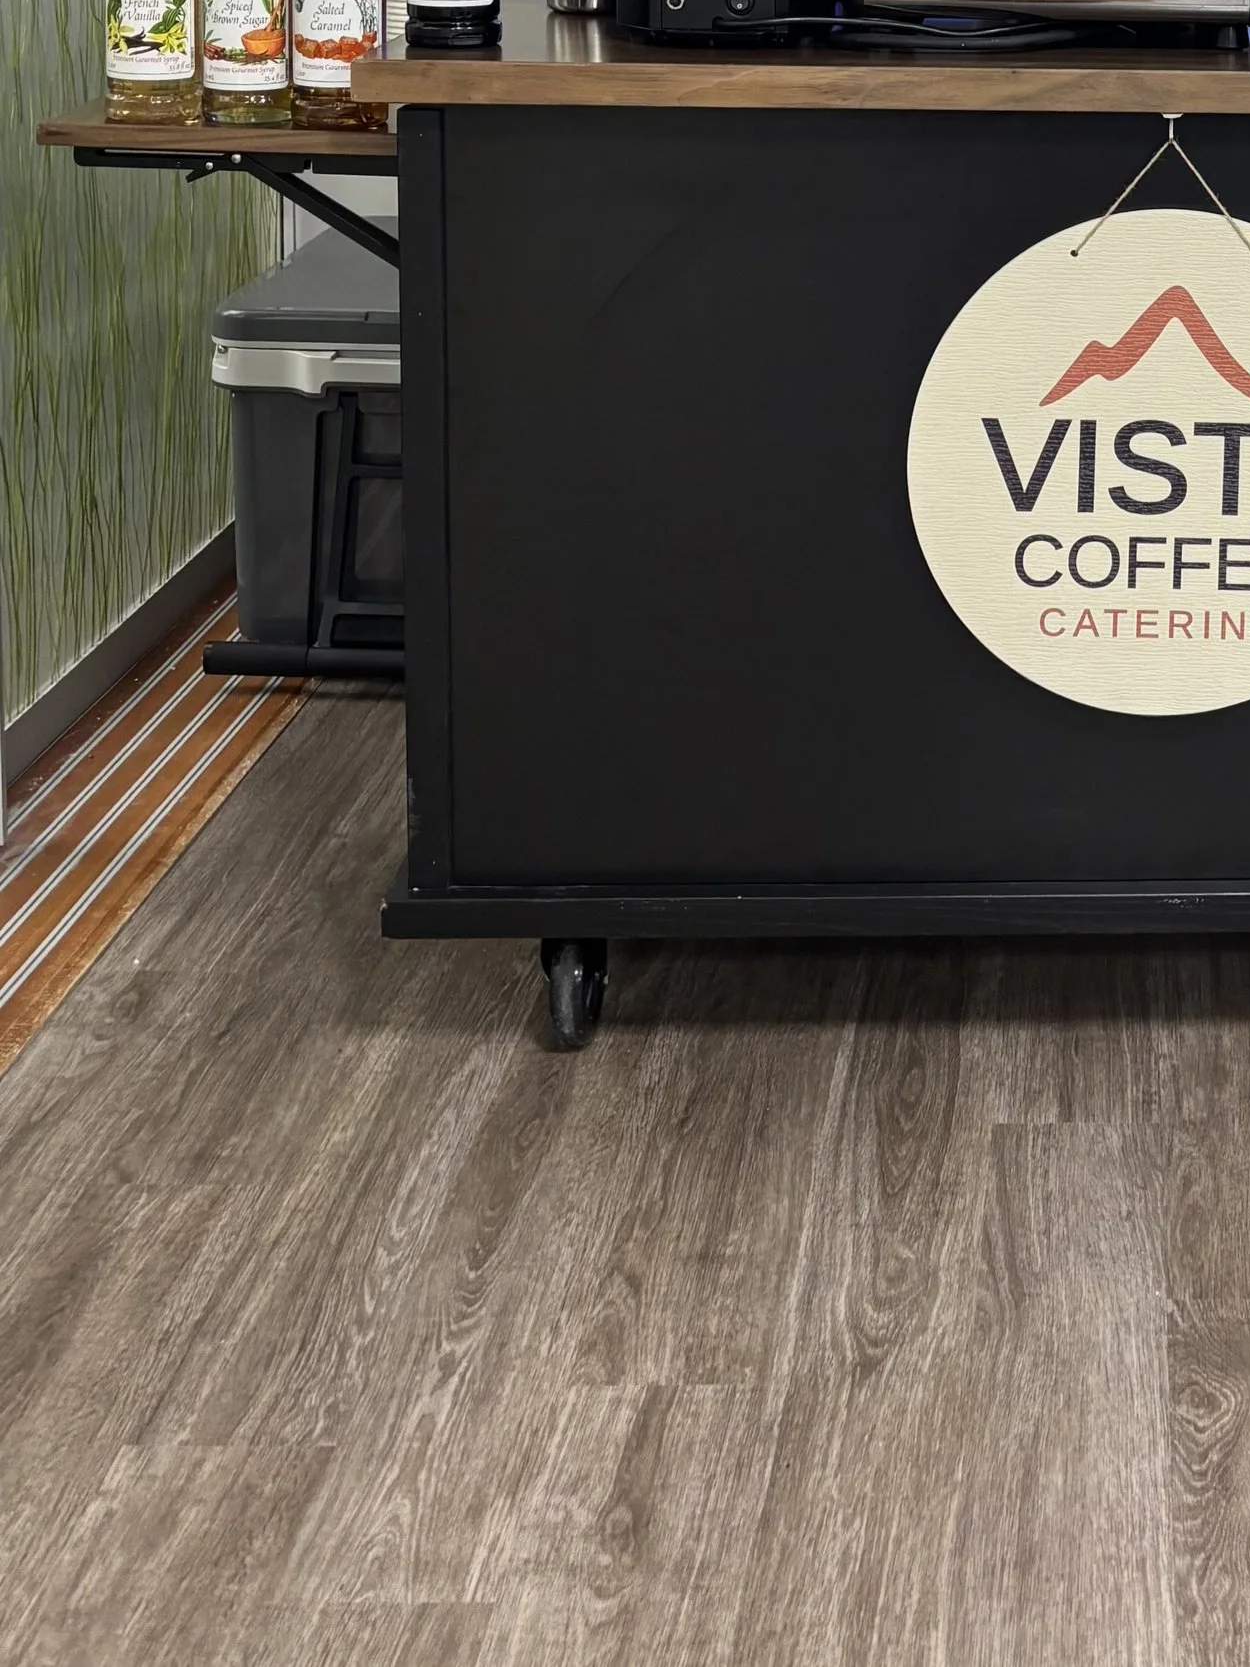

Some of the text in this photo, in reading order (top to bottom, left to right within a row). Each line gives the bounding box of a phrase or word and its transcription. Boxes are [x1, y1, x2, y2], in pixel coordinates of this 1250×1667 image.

[122, 8, 160, 21] Vanilla
[314, 1, 345, 16] Salted
[211, 11, 268, 28] Brown Sugar
[310, 16, 352, 31] Caramel
